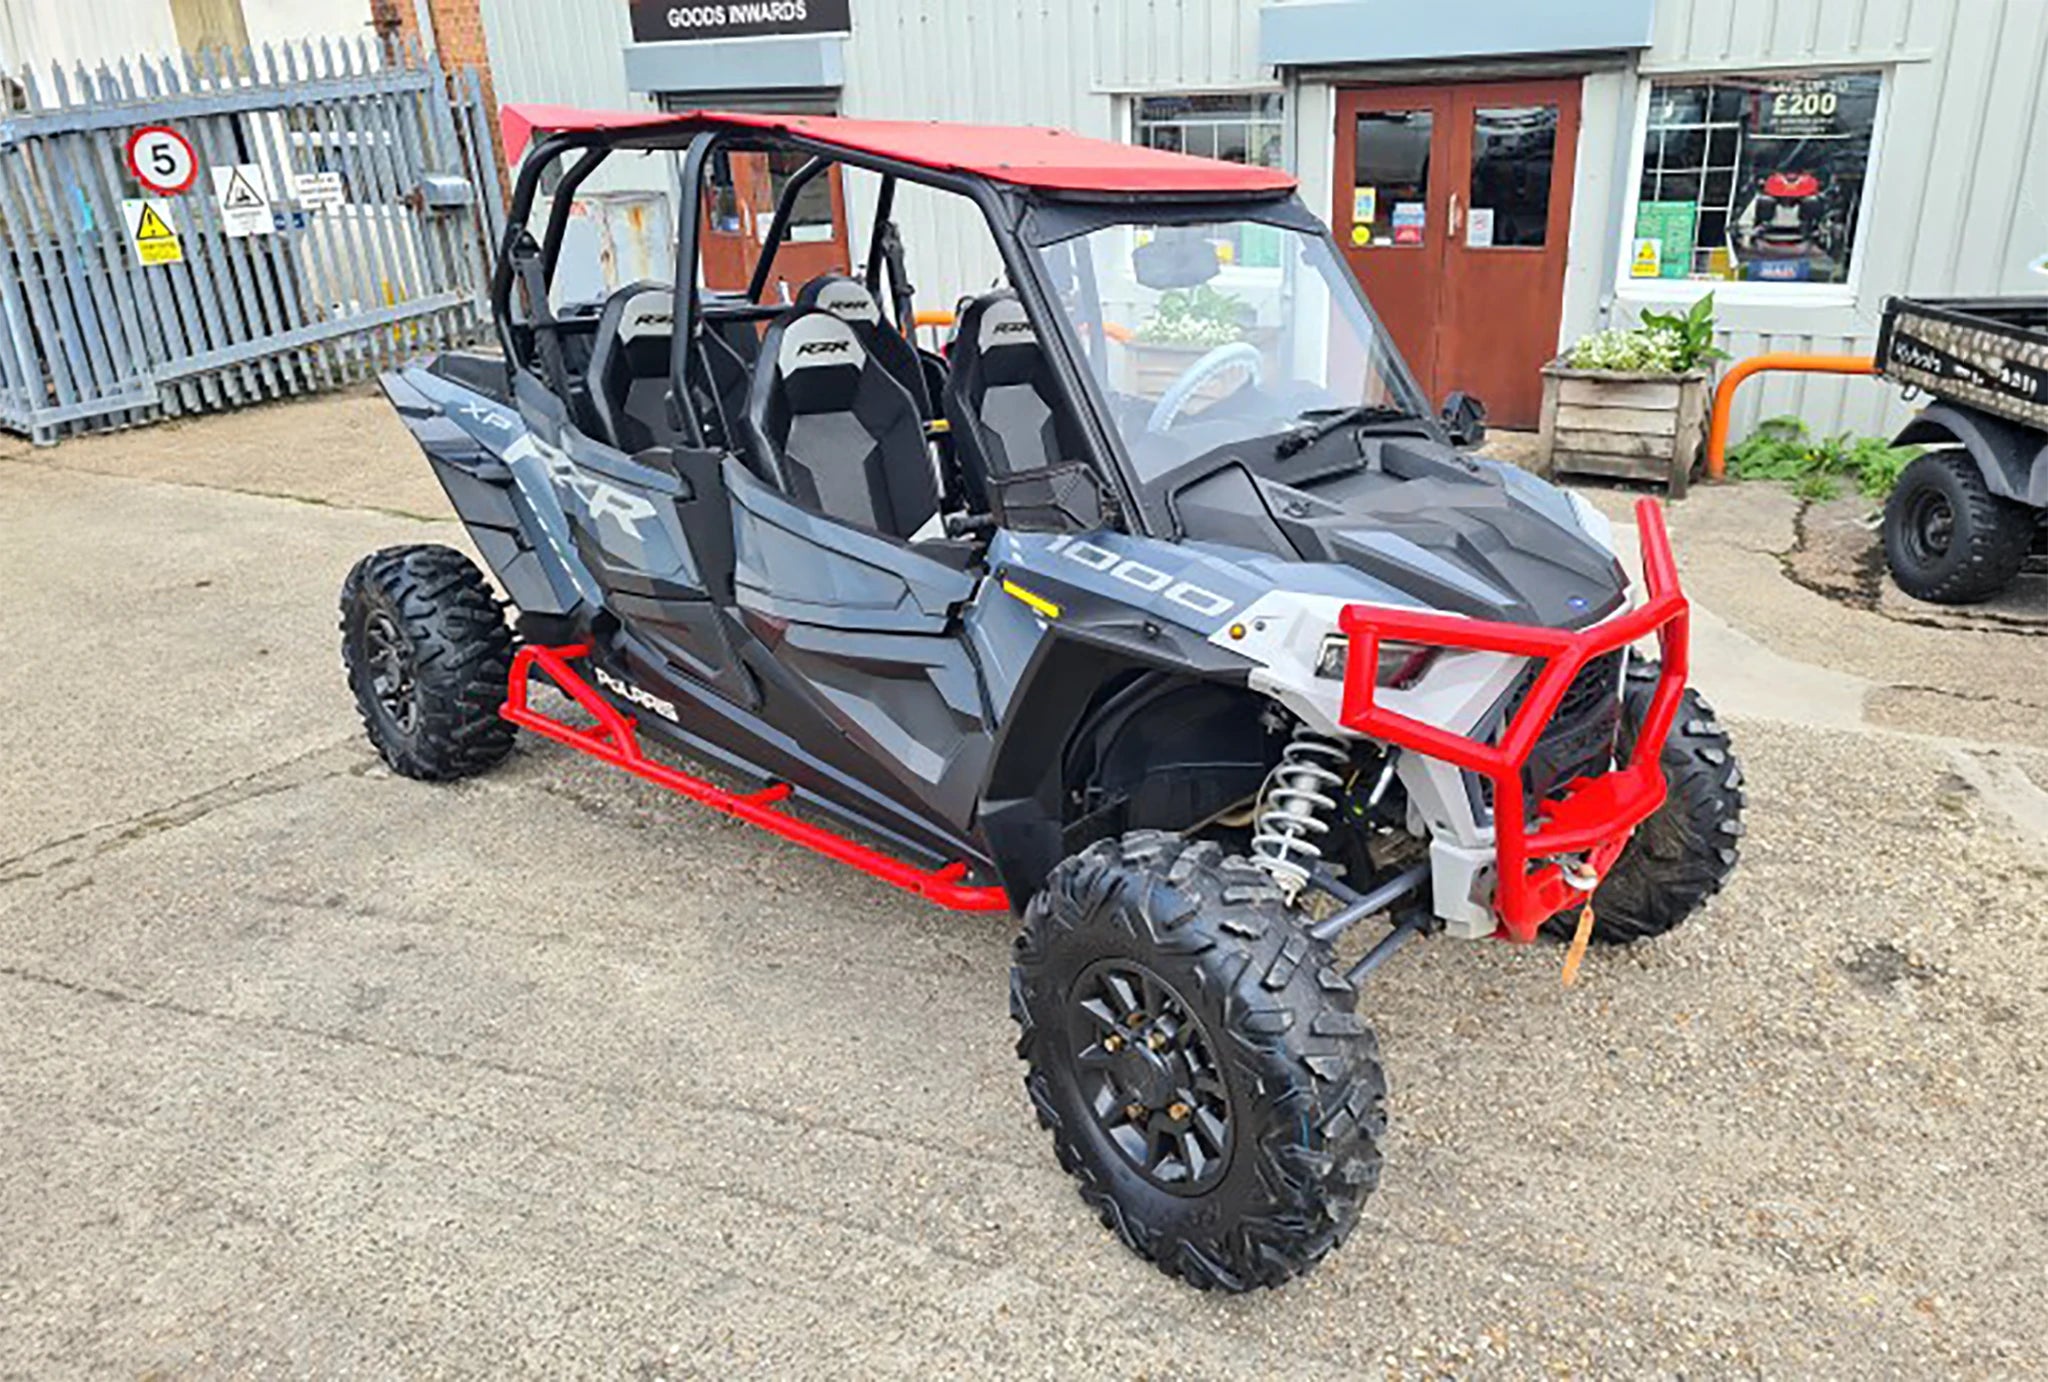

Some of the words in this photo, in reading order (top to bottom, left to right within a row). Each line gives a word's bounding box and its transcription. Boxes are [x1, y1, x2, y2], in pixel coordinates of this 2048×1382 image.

[667, 8, 726, 27] GOODS
[727, 3, 807, 24] INWARDS
[1772, 93, 1837, 116] £200
[152, 144, 176, 175] 5
[459, 400, 512, 430] XP
[1046, 535, 1235, 617] 1000
[594, 666, 680, 722] POLARIS
